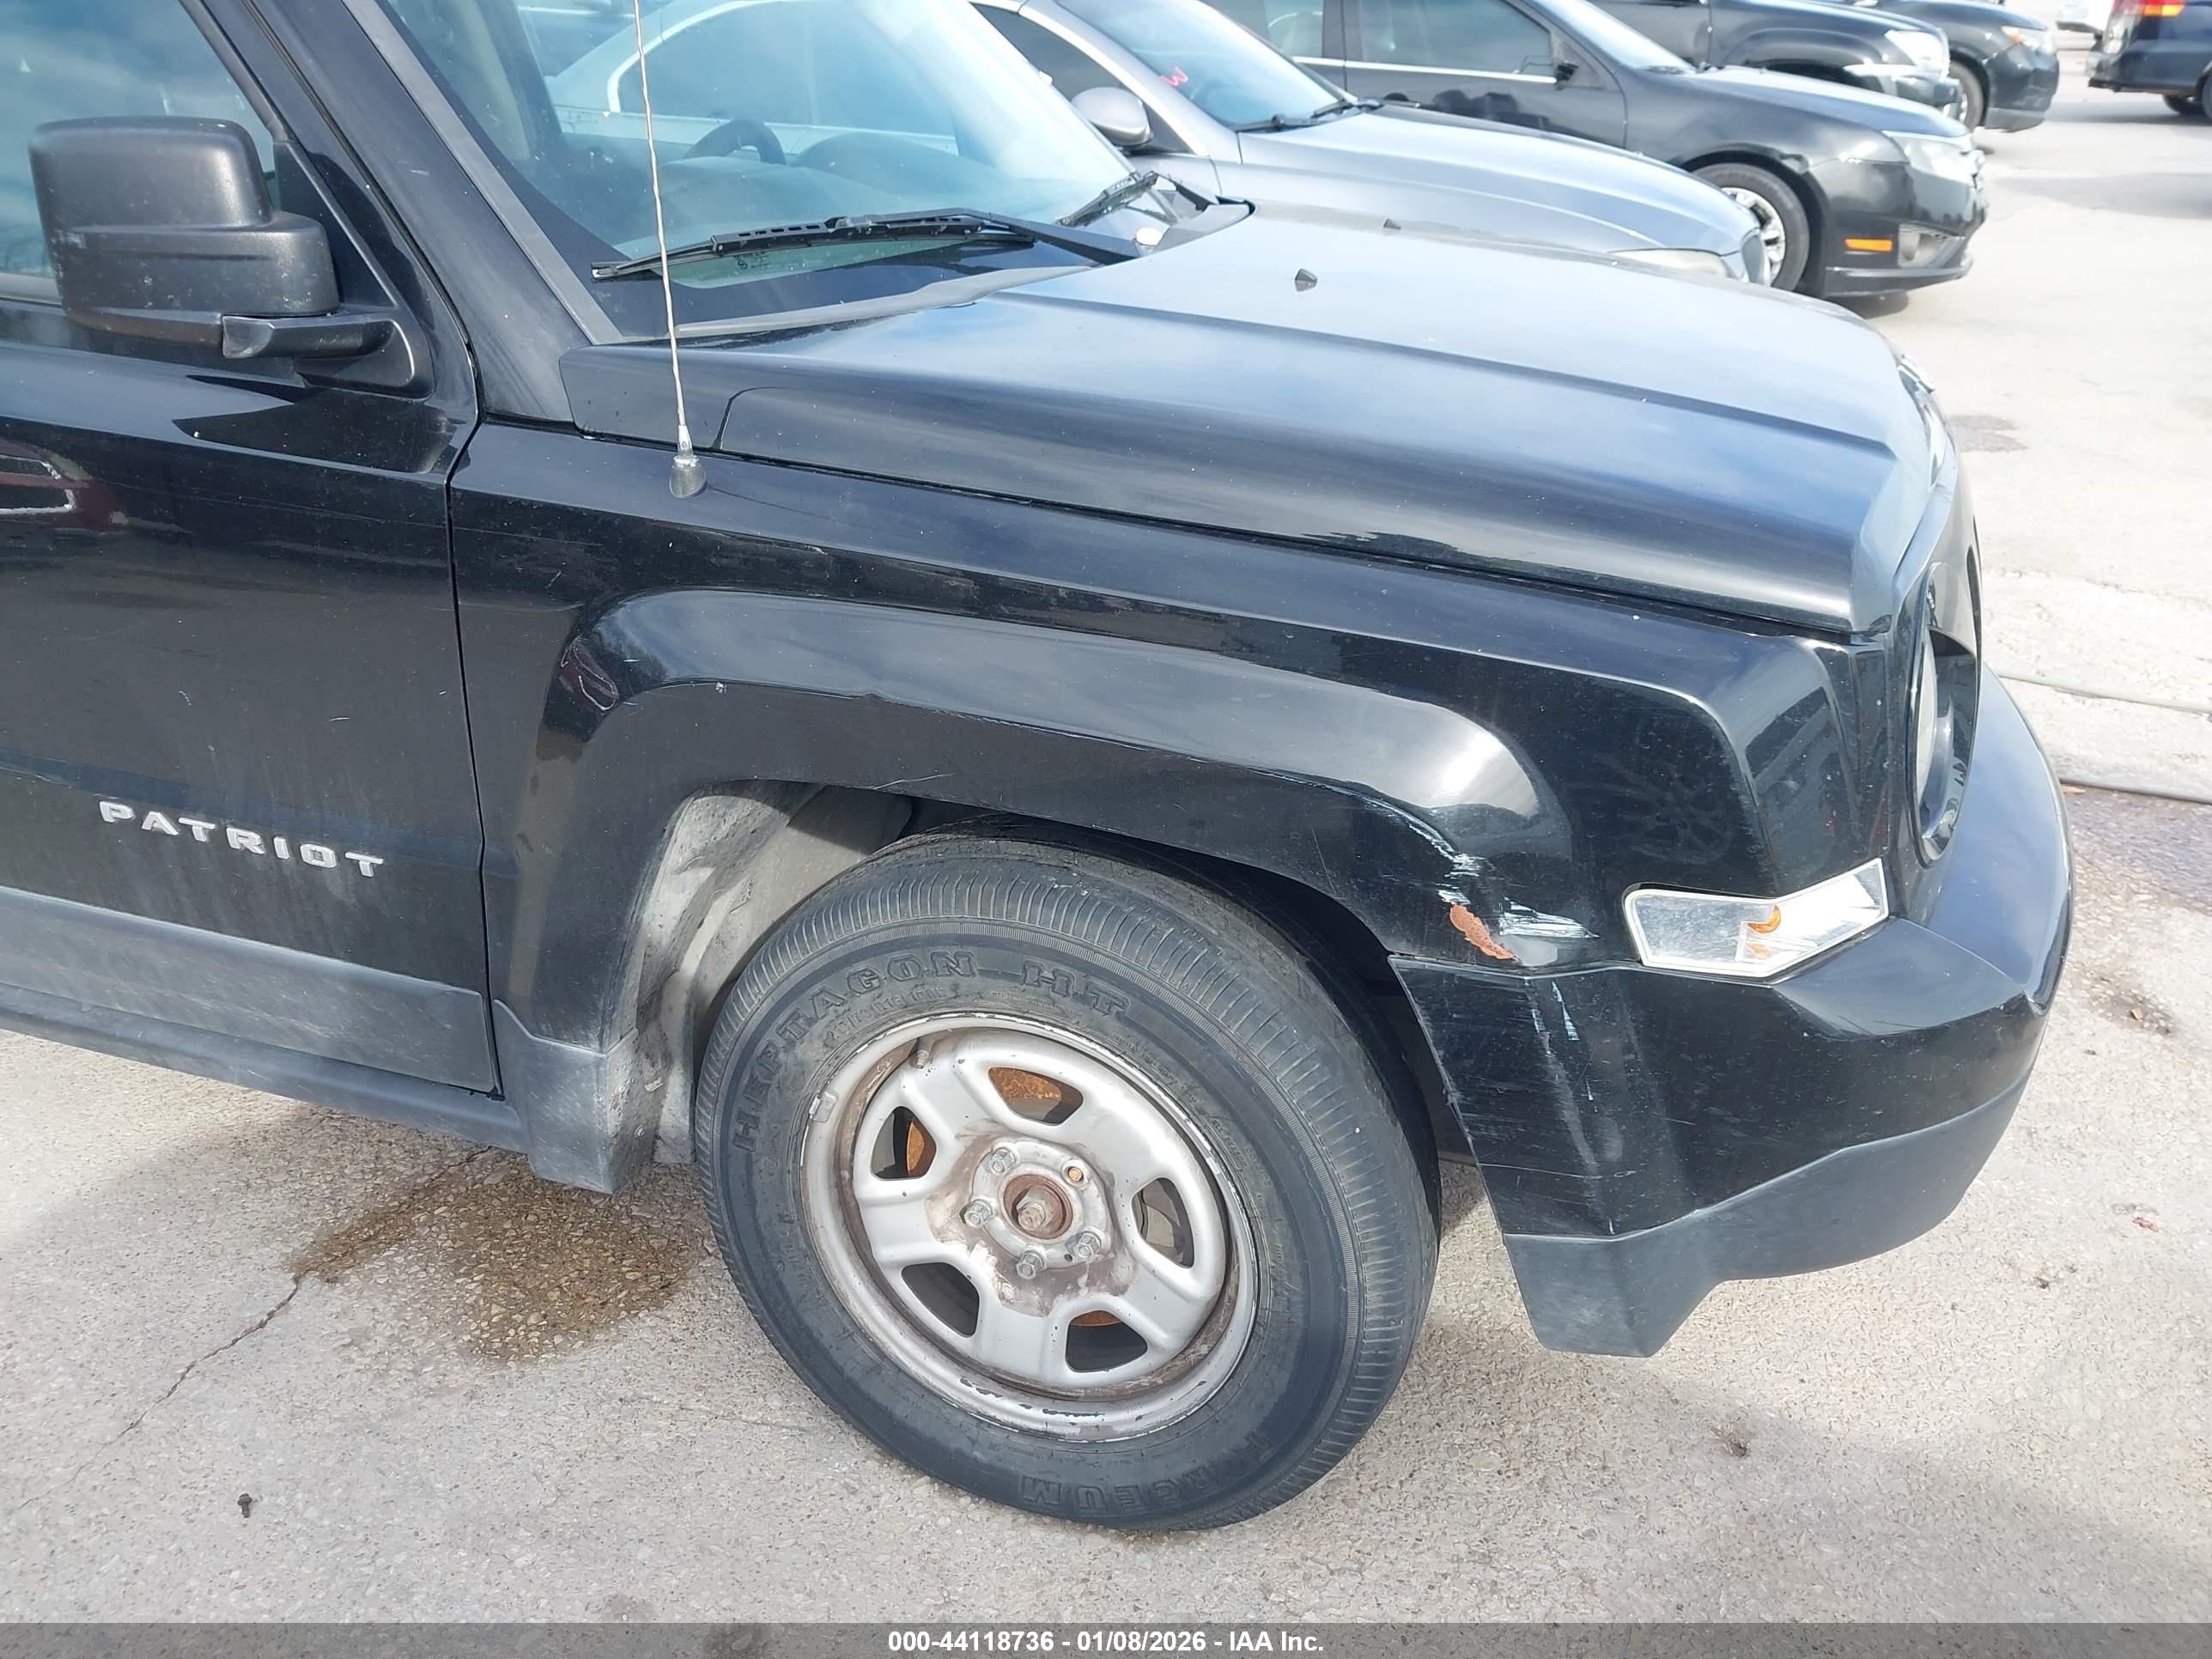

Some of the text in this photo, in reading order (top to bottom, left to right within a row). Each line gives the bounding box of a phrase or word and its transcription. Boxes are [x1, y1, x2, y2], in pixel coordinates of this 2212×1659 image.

[99, 799, 385, 878] PATRIOT
[732, 950, 977, 1152] HEPTAGON
[1022, 960, 1130, 1017] HT
